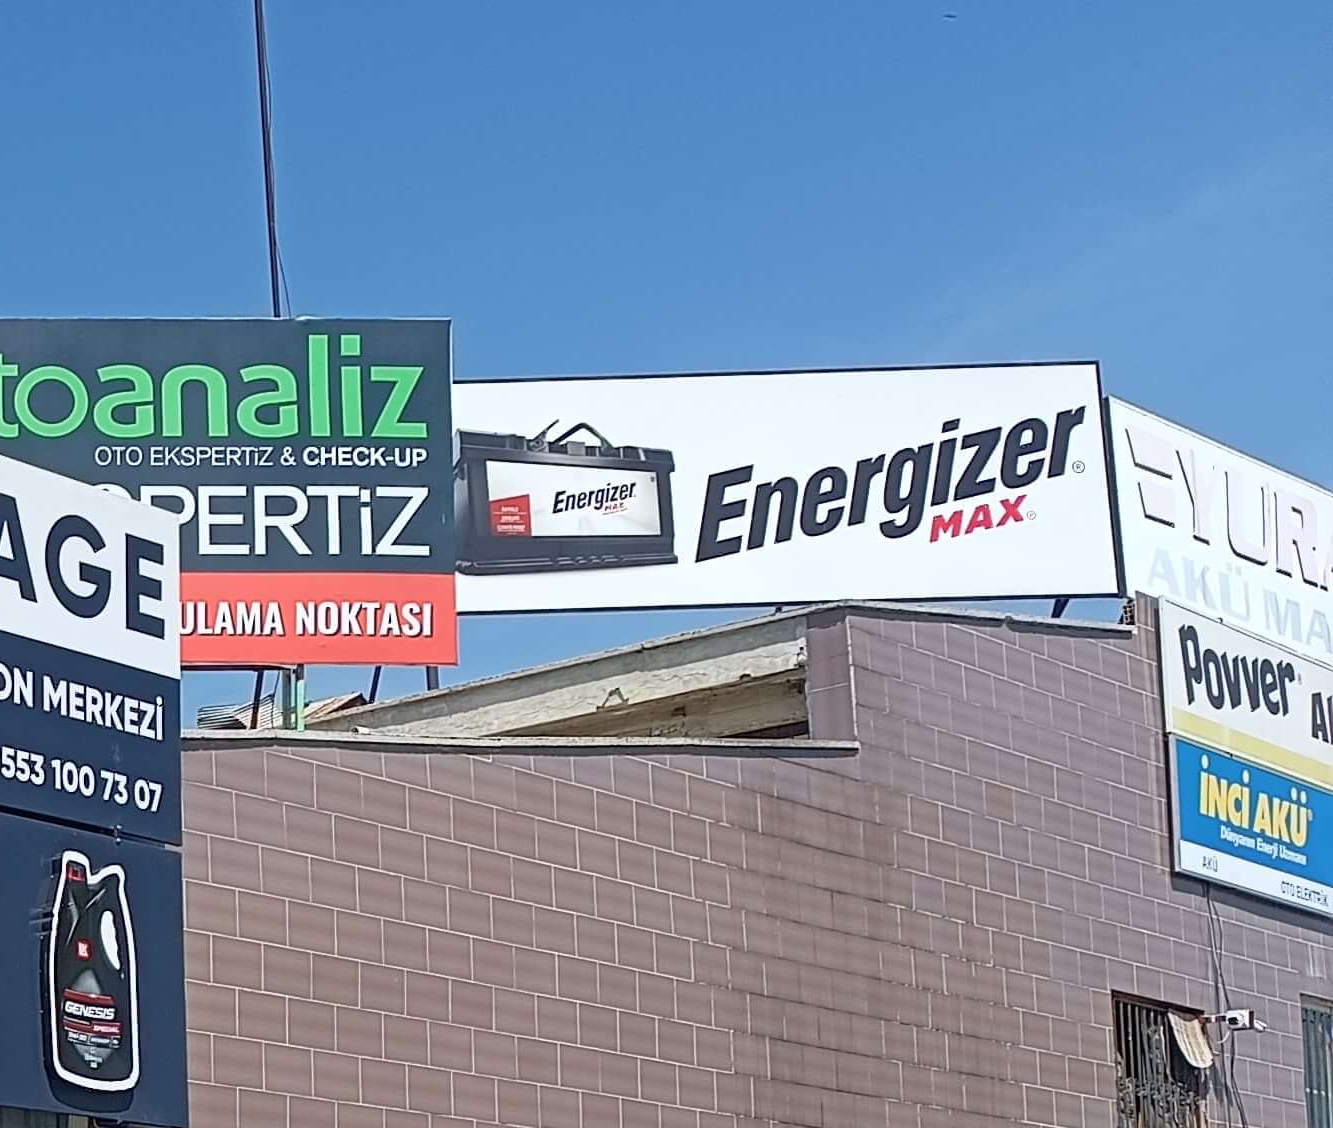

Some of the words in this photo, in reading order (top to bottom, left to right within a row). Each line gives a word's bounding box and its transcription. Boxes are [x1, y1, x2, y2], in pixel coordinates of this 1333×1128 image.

[94, 446, 143, 468] OTO
[280, 447, 297, 467] &
[302, 446, 428, 468] CHECK-UP
[551, 482, 637, 515] Energizer
[695, 404, 1086, 563] Energizer
[930, 494, 1027, 543] MAX
[295, 599, 433, 638] NOKTASI
[42, 691, 165, 742] MERKEZİ
[50, 757, 96, 798] 100
[100, 773, 129, 806] 73
[133, 780, 162, 814] 07
[1252, 786, 1309, 848] AKÜ
